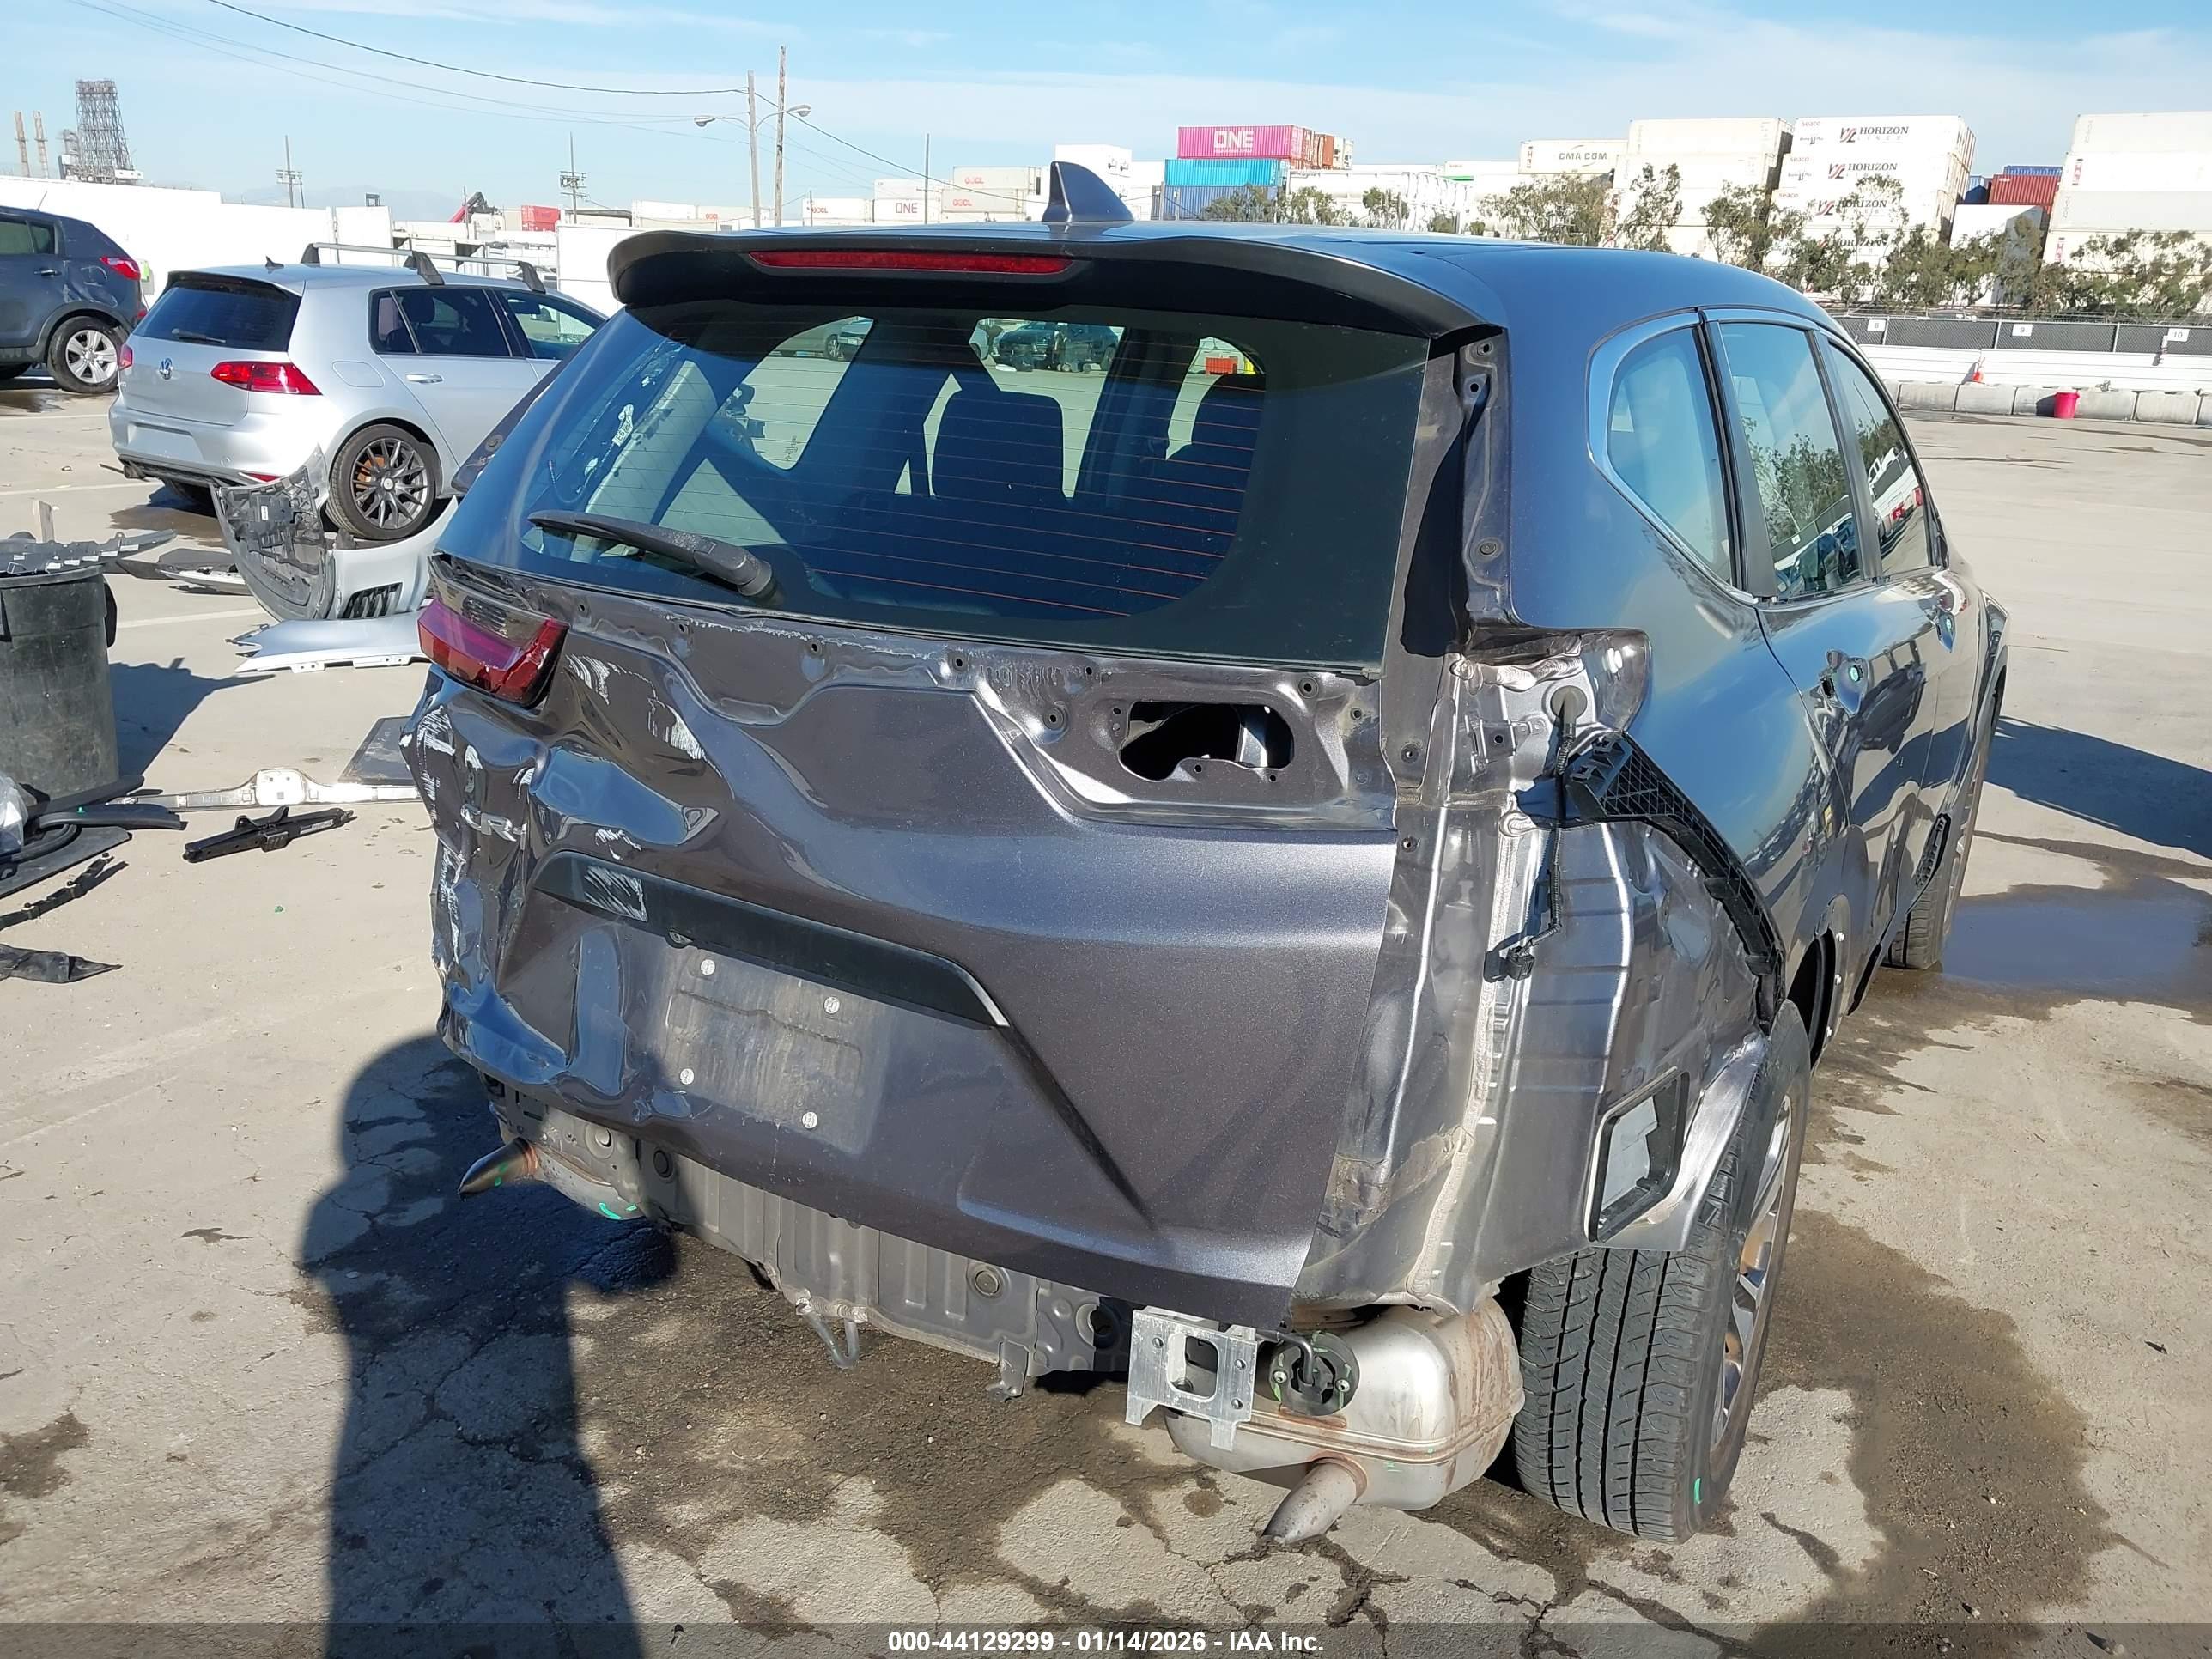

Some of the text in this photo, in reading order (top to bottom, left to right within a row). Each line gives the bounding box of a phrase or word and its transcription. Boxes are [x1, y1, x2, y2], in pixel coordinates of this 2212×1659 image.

[1859, 126, 1909, 135] HORIZON
[1213, 130, 1254, 148] ONE
[1559, 152, 1607, 161] CMA CGM
[1848, 162, 1899, 171] HORIZON
[896, 203, 918, 214] ONE
